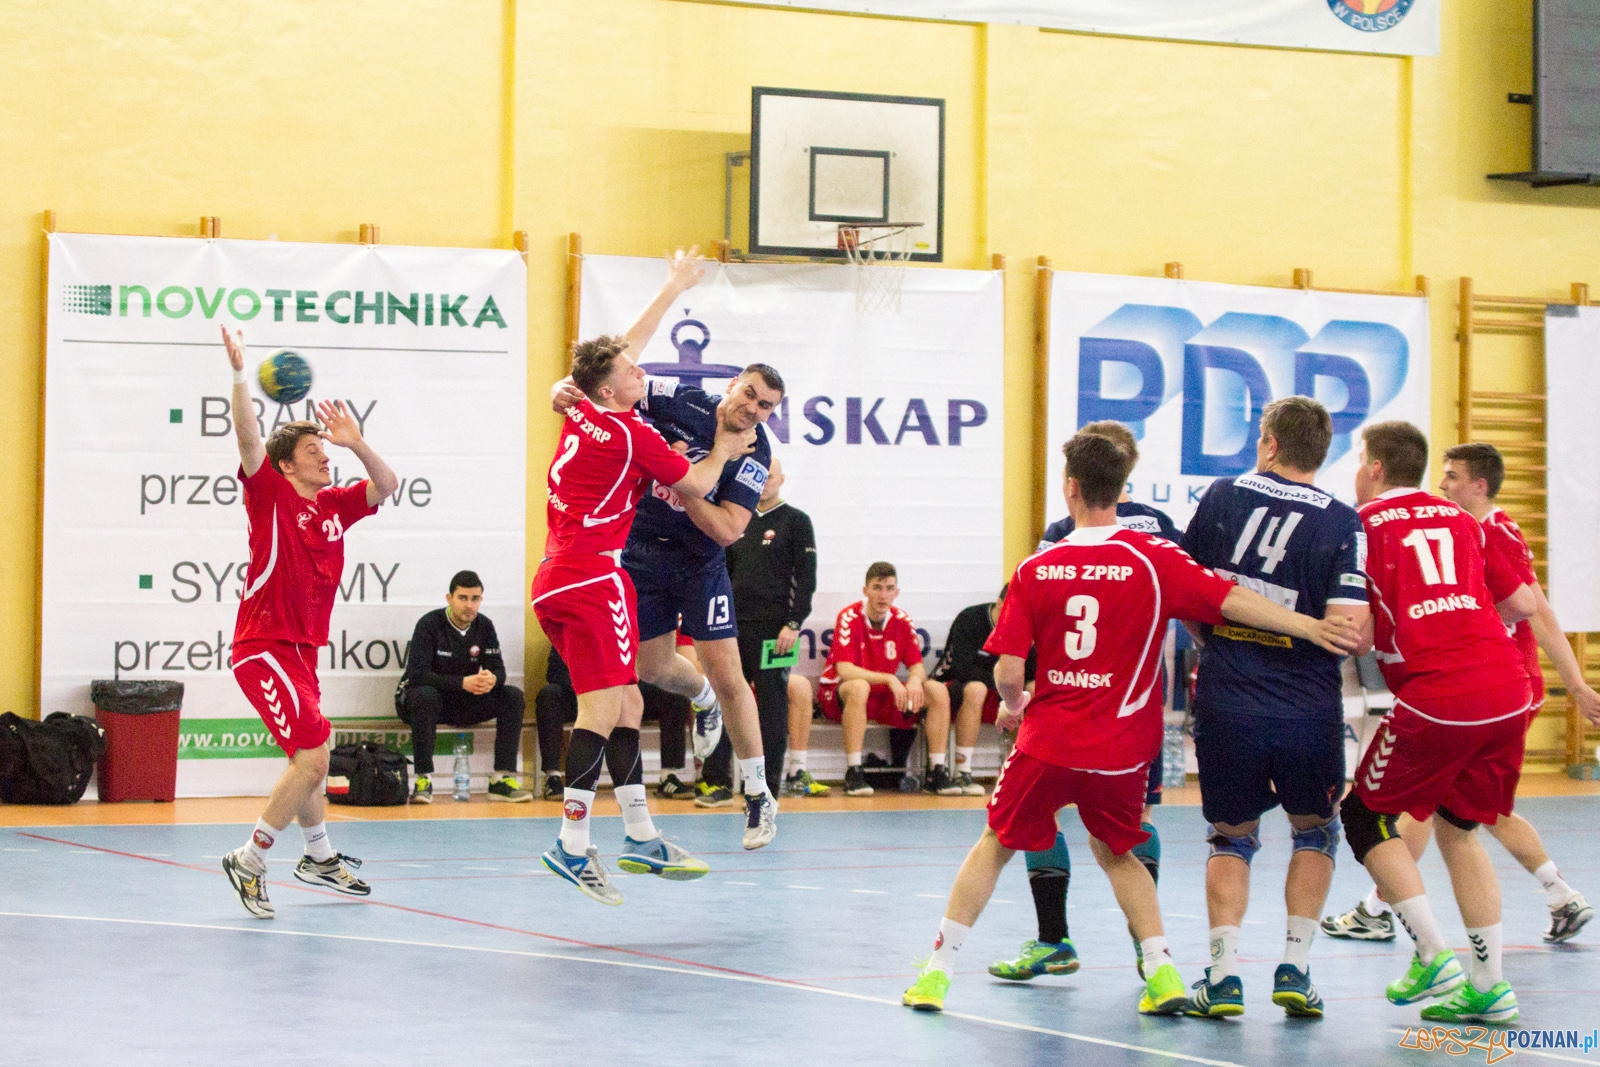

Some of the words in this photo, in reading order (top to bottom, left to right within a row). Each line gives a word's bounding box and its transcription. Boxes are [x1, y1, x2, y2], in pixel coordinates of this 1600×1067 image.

[1350, 8, 1401, 31] POLSCE
[1077, 330, 1374, 477] PDP
[564, 405, 585, 423] MS
[579, 418, 612, 443] ZPRP
[550, 434, 580, 486] 2
[740, 461, 769, 487] PD
[1368, 507, 1411, 527] SMS
[1413, 505, 1460, 519] ZPRP
[1230, 506, 1304, 574] 14
[1402, 527, 1458, 586] 17
[1036, 565, 1077, 580] SMS
[1081, 565, 1134, 581] ZPRP
[707, 595, 730, 626] 13
[1409, 593, 1482, 619] GDAŃSK
[1064, 594, 1100, 661] 3
[884, 640, 897, 660] 8
[1047, 669, 1114, 689] GDAŃSK
